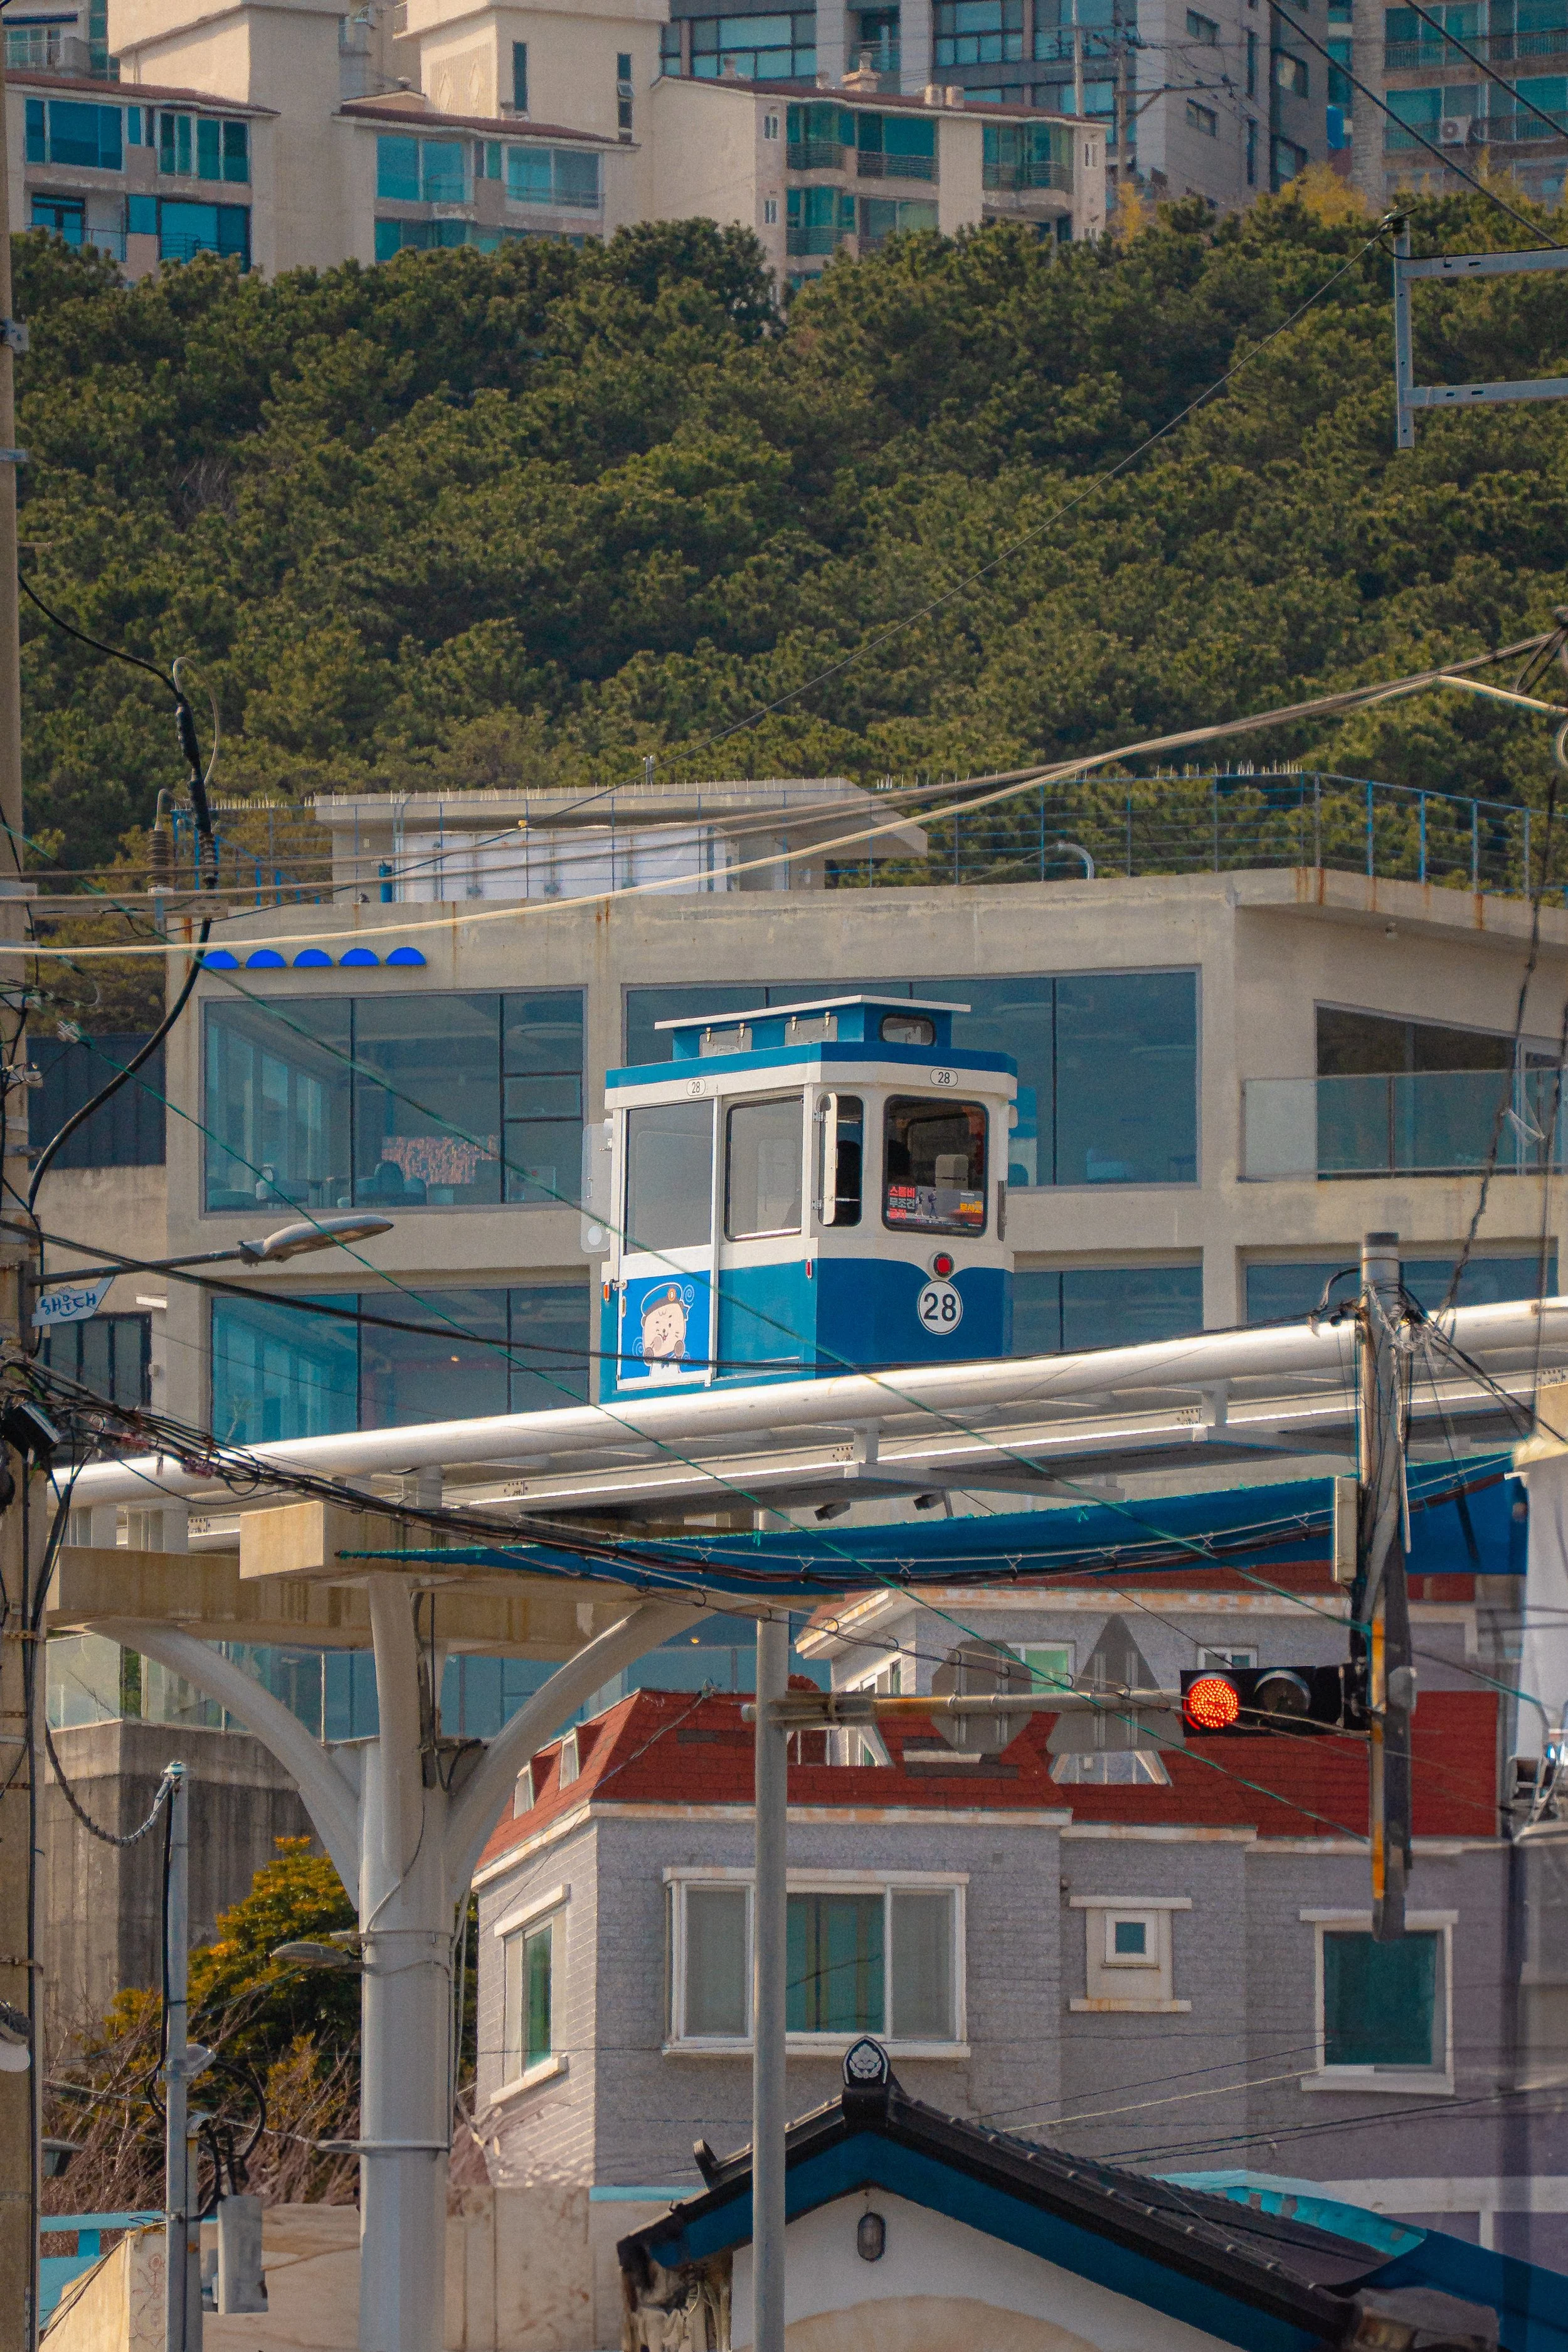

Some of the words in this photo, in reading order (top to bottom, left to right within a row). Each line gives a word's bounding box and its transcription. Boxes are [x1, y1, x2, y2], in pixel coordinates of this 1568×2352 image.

[691, 1081, 701, 1093] 28
[938, 1071, 950, 1084] 28
[41, 1292, 97, 1317] 해운대
[923, 1292, 957, 1322] 28
